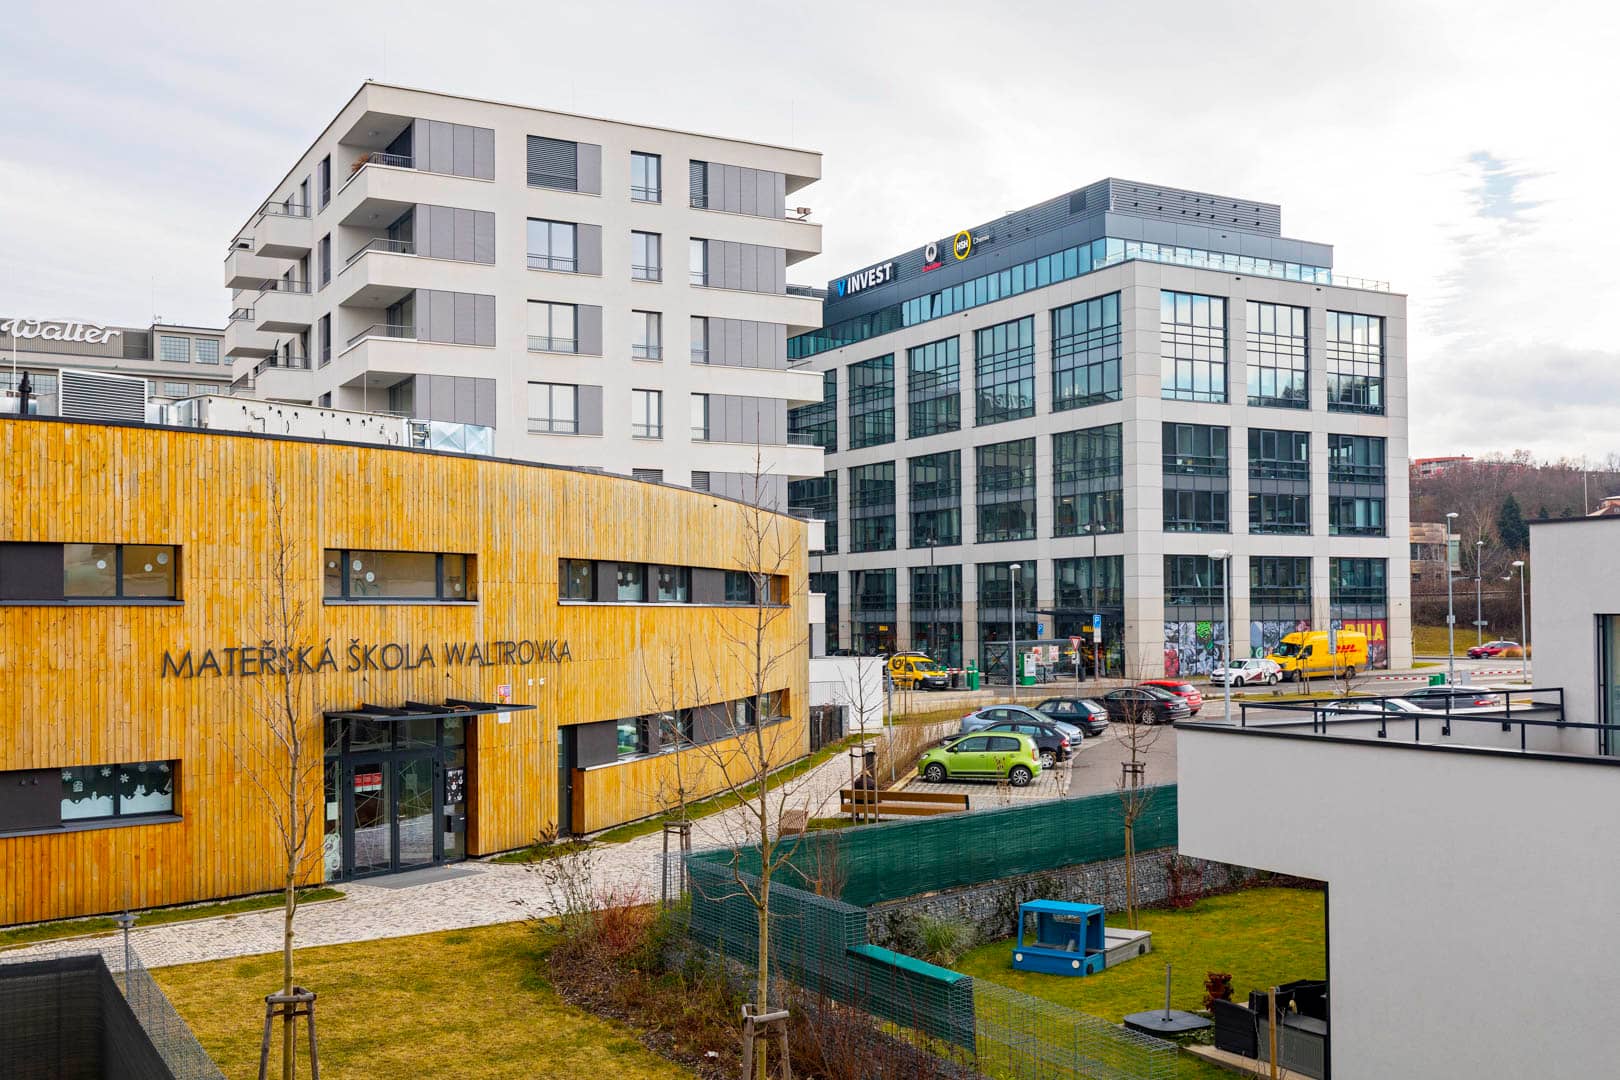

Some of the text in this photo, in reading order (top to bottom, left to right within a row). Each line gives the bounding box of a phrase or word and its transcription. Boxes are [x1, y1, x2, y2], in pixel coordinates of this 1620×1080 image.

[0, 317, 120, 344] Walter
[161, 638, 573, 678] MATEŘSKÁ ŠKOLA WALTROVKA
